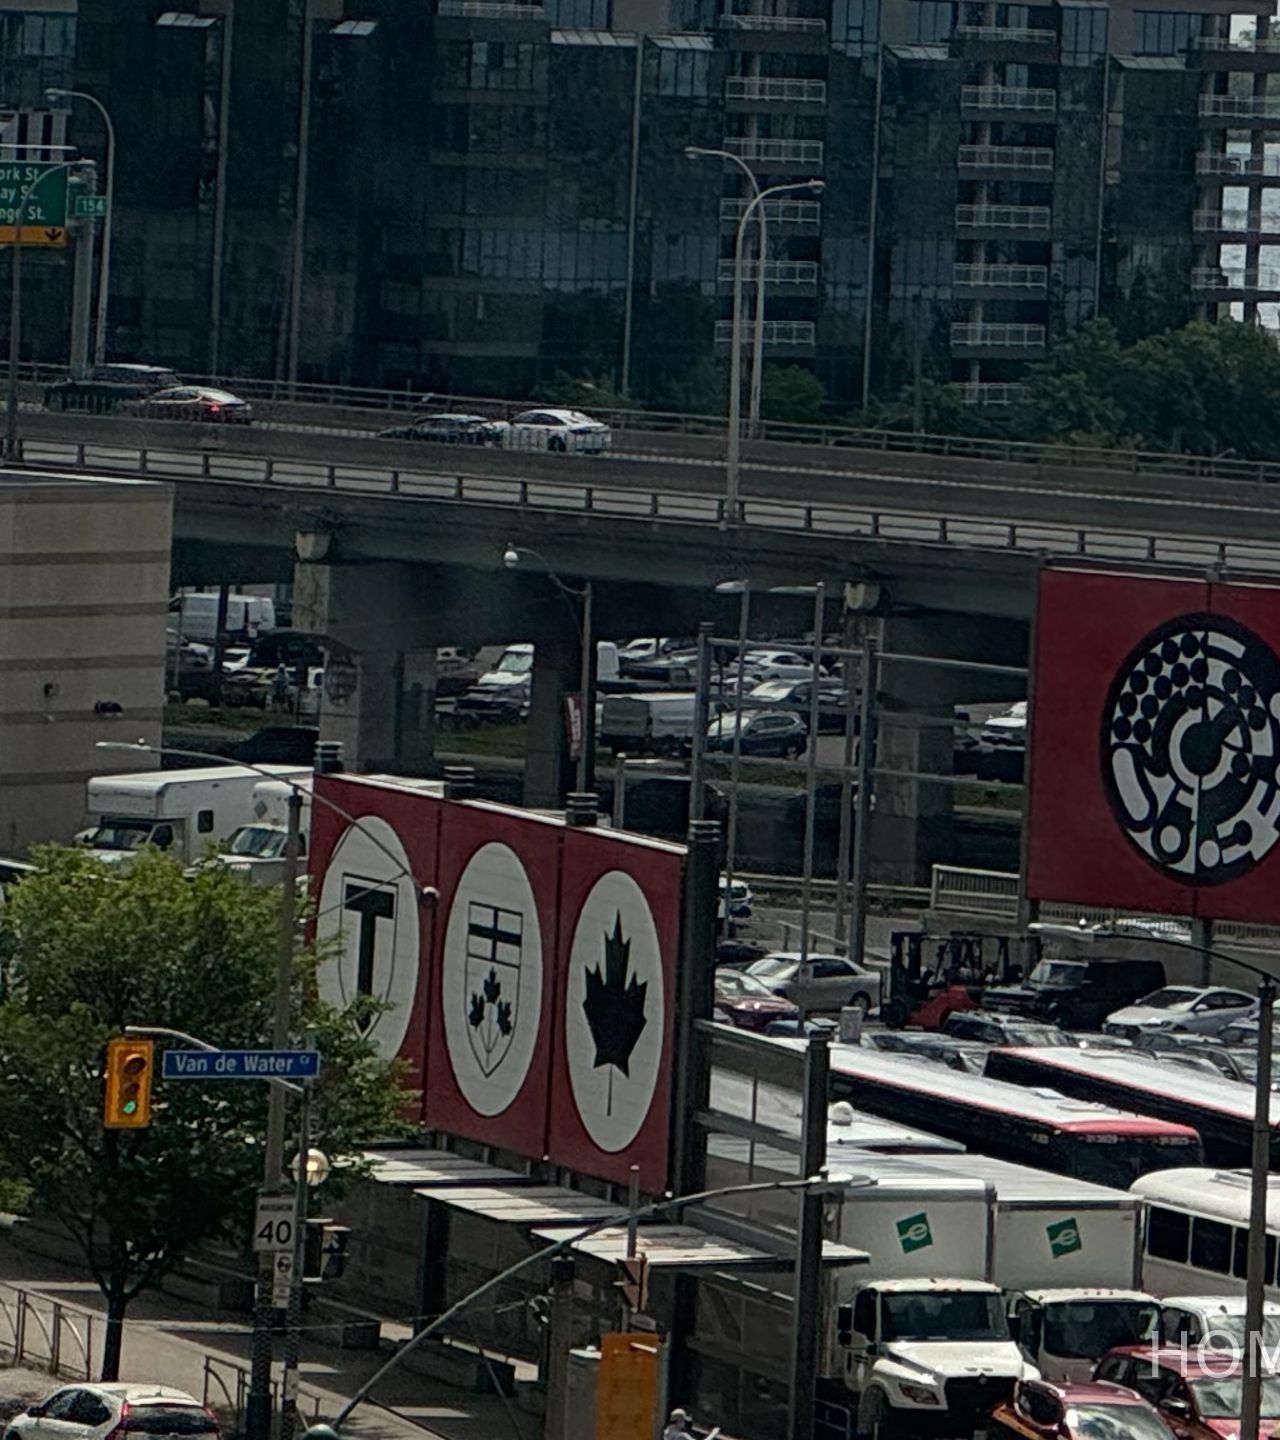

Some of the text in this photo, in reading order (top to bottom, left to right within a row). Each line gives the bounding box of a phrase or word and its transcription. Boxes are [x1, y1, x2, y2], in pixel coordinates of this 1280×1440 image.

[0, 187, 16, 202] ay
[175, 1054, 208, 1073] Van
[215, 1054, 237, 1073] de
[244, 1054, 294, 1073] Water
[257, 1220, 292, 1245] 40
